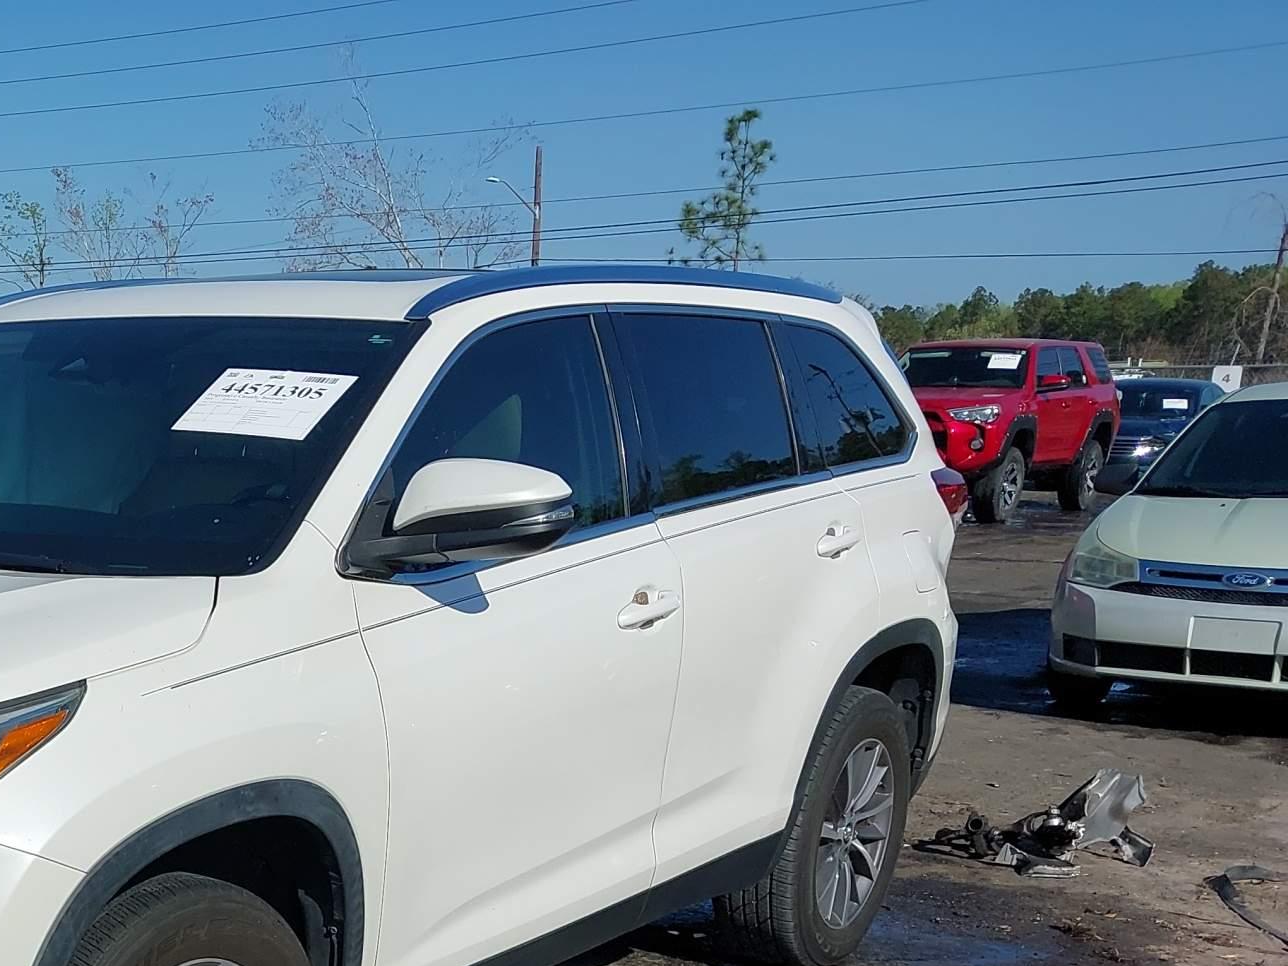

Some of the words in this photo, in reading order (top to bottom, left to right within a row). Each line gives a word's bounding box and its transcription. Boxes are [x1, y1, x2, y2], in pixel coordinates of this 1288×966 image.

[1222, 374, 1232, 384] 4
[220, 382, 329, 399] 44571305
[1231, 575, 1259, 585] Ford
